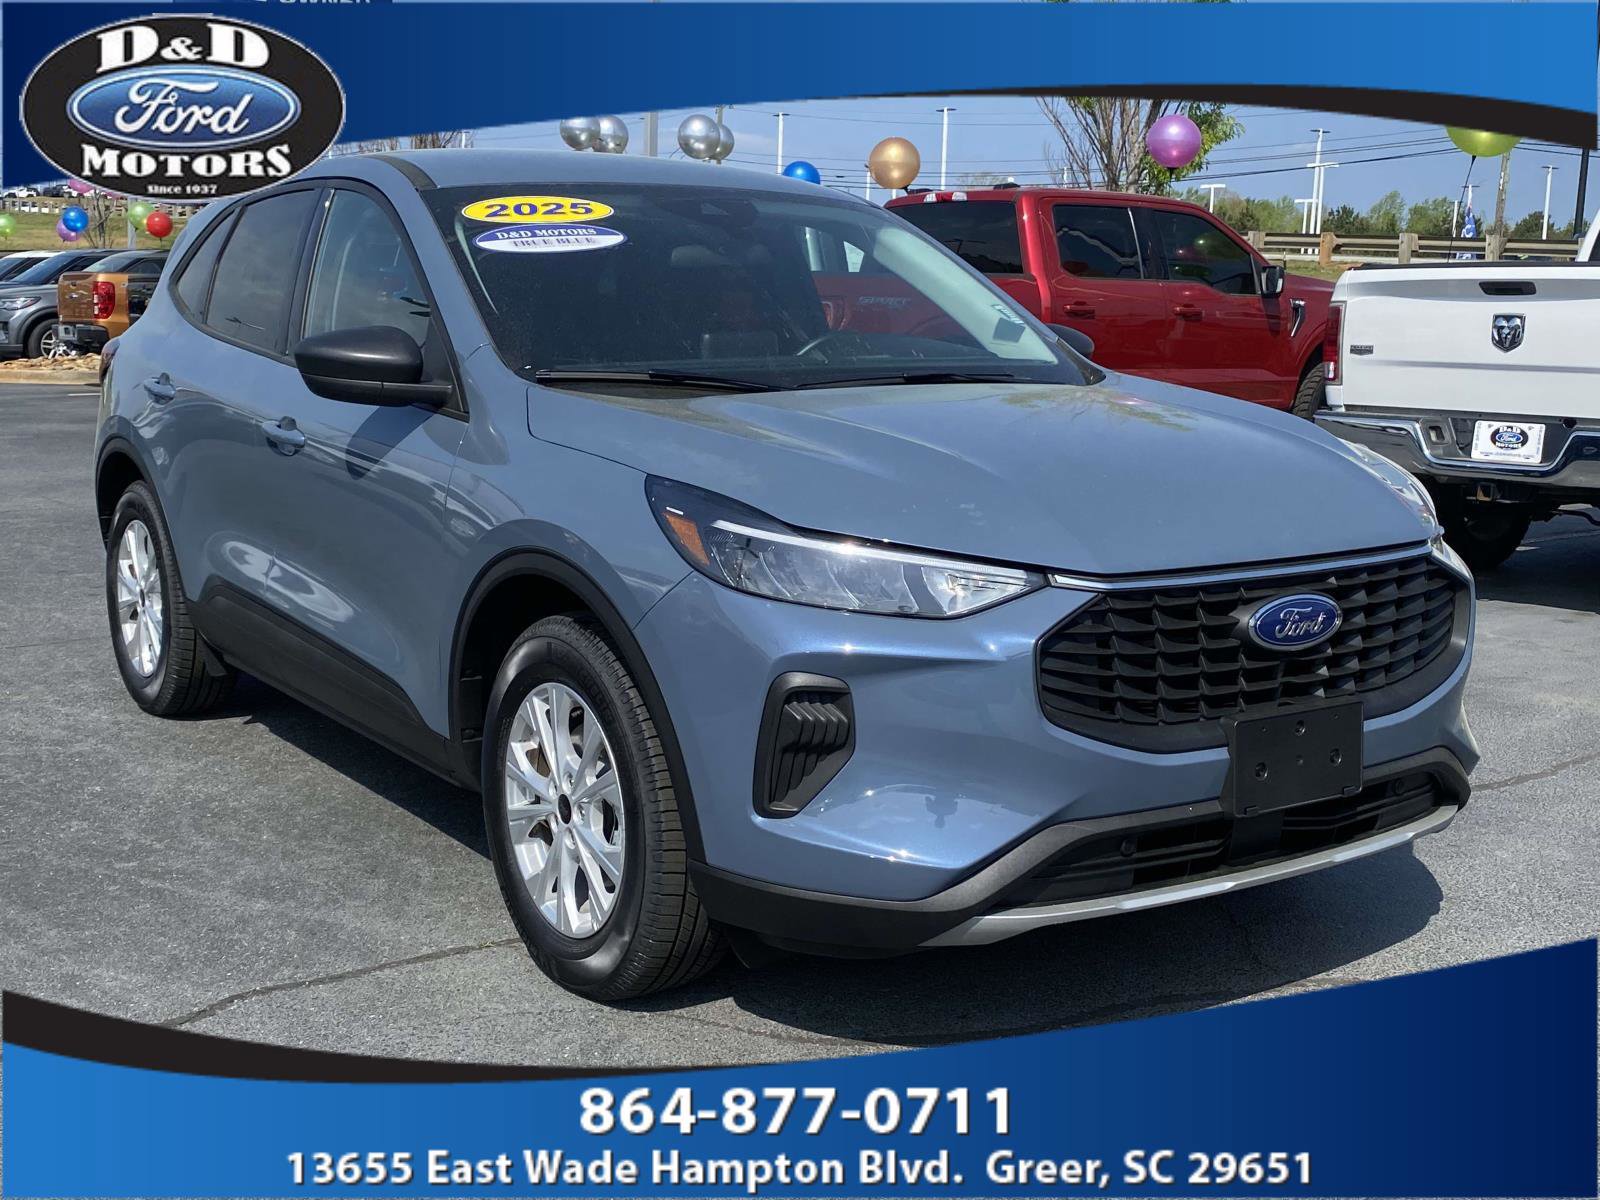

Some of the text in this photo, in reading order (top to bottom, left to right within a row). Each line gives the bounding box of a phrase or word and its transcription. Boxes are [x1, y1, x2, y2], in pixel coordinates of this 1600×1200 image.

[484, 202, 593, 218] 2025
[496, 228, 597, 240] D&D MOTORS
[1275, 606, 1327, 639] Ford
